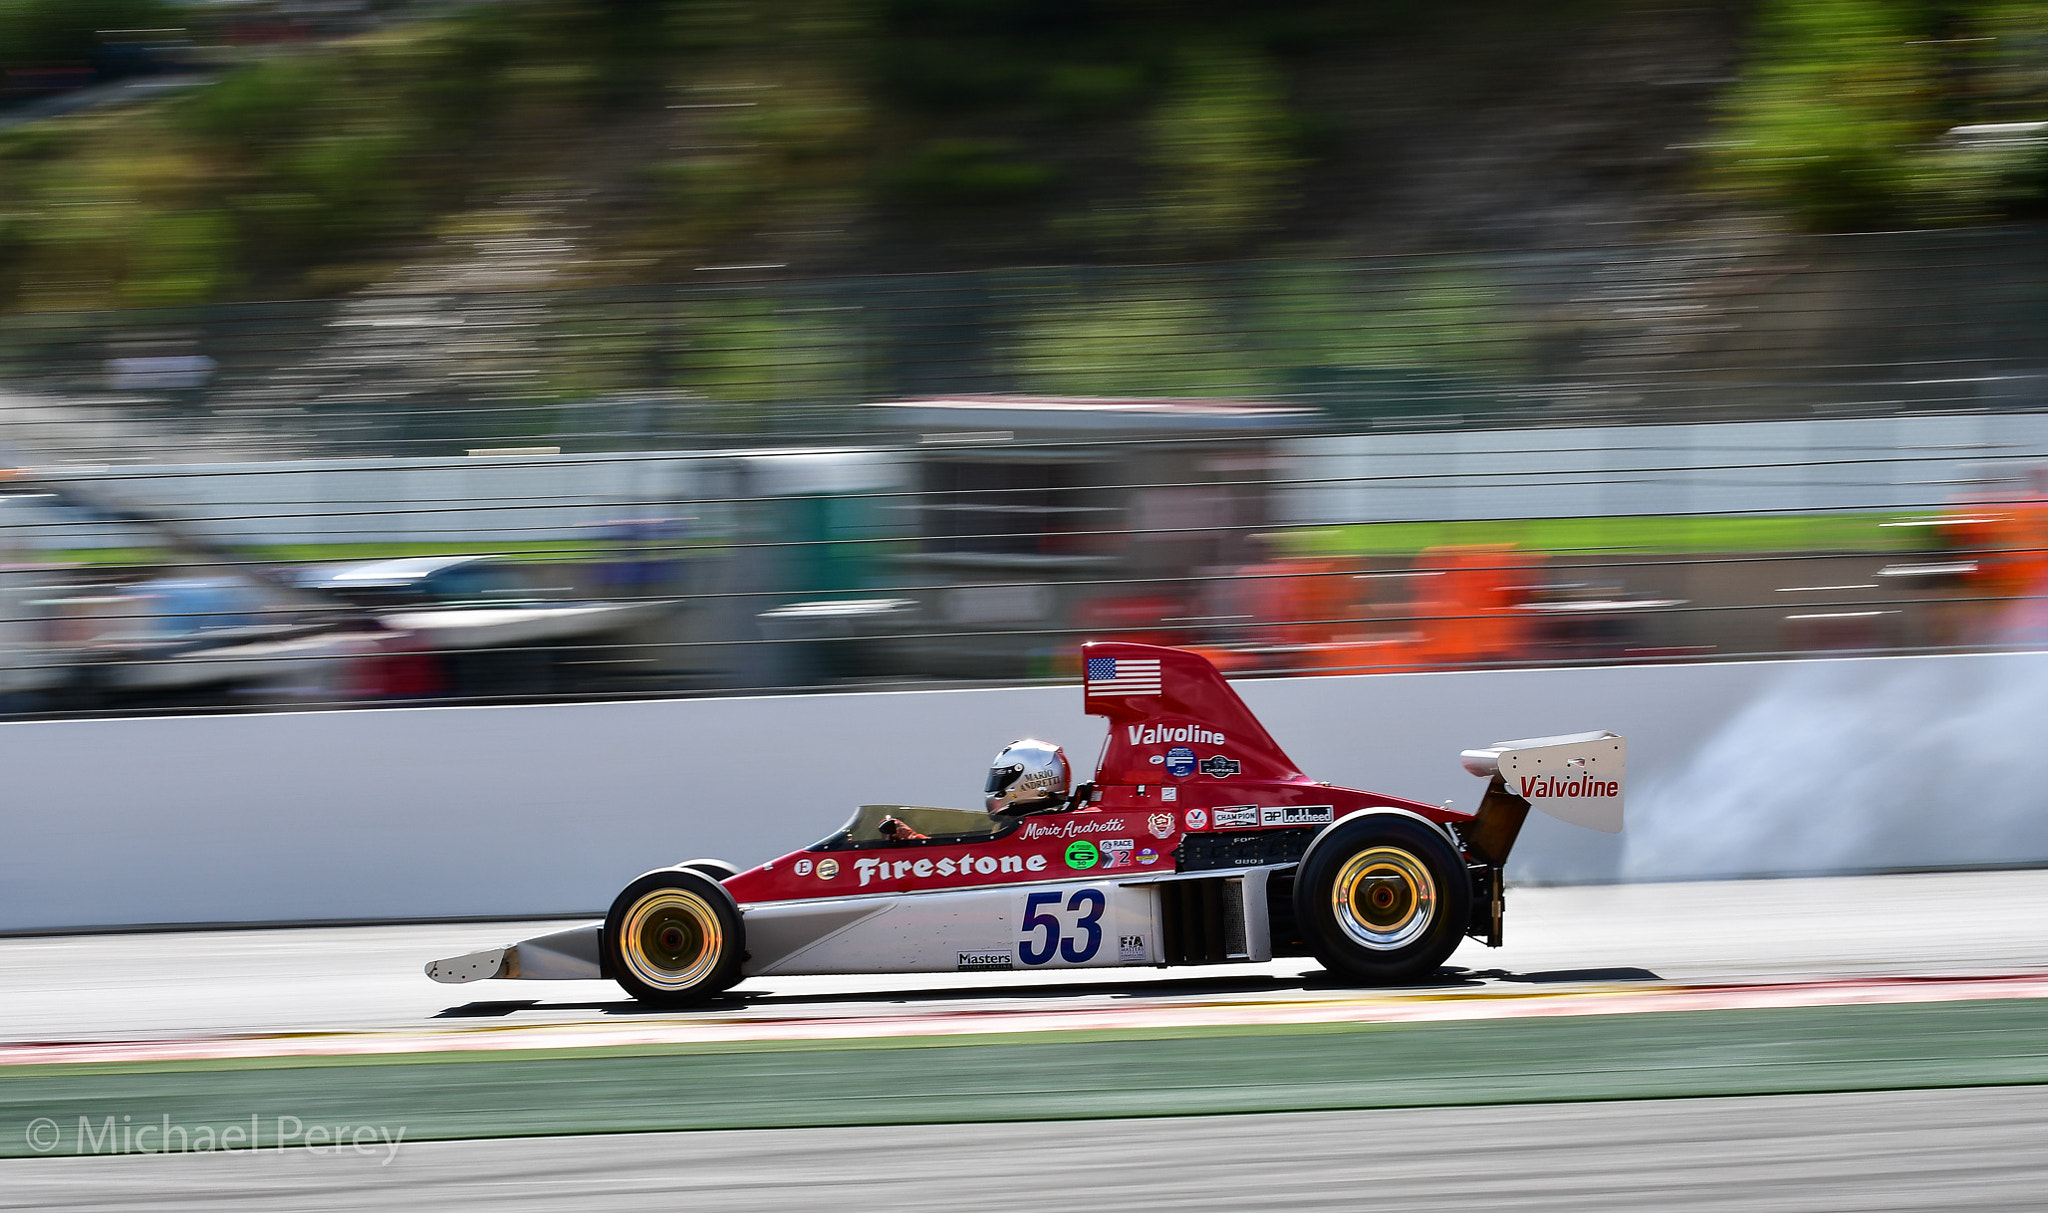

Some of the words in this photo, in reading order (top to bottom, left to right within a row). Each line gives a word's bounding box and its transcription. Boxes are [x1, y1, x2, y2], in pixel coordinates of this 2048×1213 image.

[1128, 723, 1225, 746] Valvoline
[1020, 775, 1061, 792] ANDRETTI
[1024, 769, 1054, 782] MARIO
[1520, 775, 1619, 798] Valvoline
[1216, 812, 1255, 821] CHAMPION
[1019, 823, 1061, 840] Mario
[1057, 818, 1125, 838] Andretti
[1119, 851, 1130, 864] 2
[799, 861, 809, 874] E
[853, 853, 1048, 887] Firestone
[1018, 888, 1107, 966] 53
[959, 953, 1011, 964] Masters
